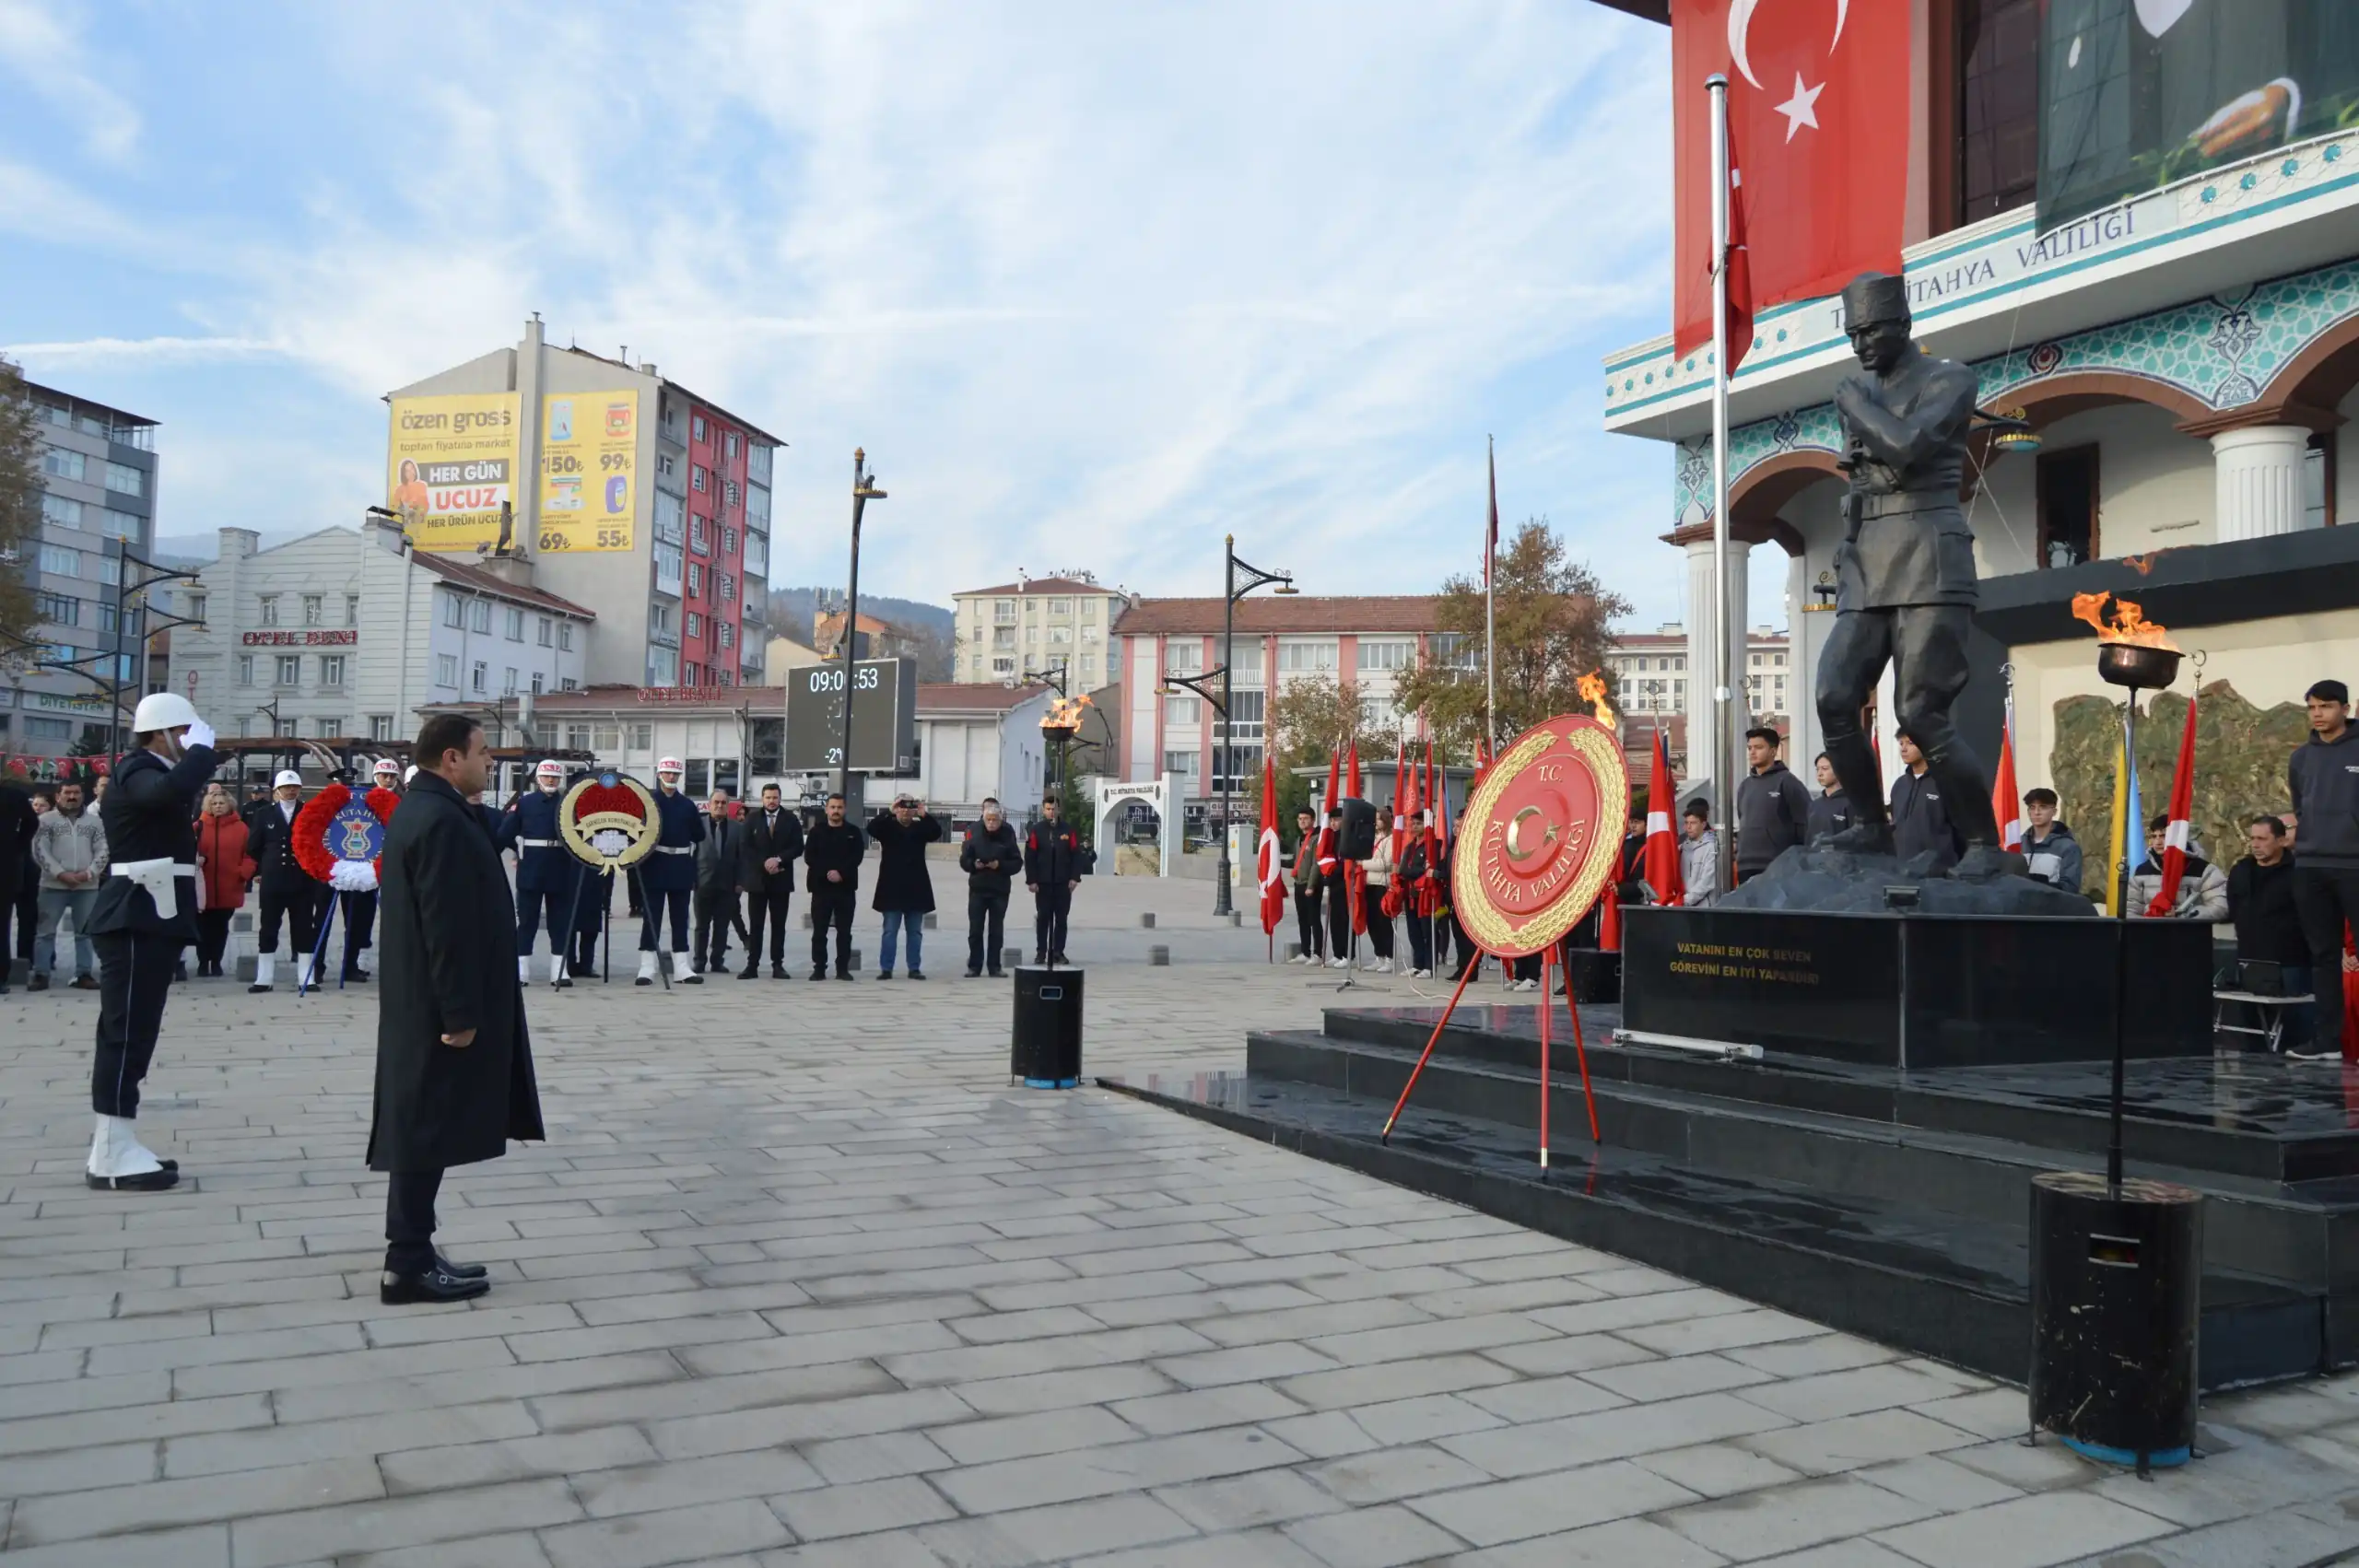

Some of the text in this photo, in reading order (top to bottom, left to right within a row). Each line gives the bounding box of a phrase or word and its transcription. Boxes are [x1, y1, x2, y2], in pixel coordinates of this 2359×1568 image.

[453, 410, 511, 434] gross
[429, 461, 502, 483] HER GÜN
[435, 487, 498, 510] UCUZ
[428, 519, 446, 529] HER
[448, 514, 476, 527] ÜRÜN
[810, 668, 878, 692] 09:0:53
[1677, 942, 1725, 956] VATANINI
[1729, 946, 1743, 957] EN
[1746, 948, 1769, 960] ÇOK
[1670, 960, 1719, 976] GÖREVİNİ
[1722, 965, 1738, 977] EN
[1741, 965, 1756, 979] İYİ
